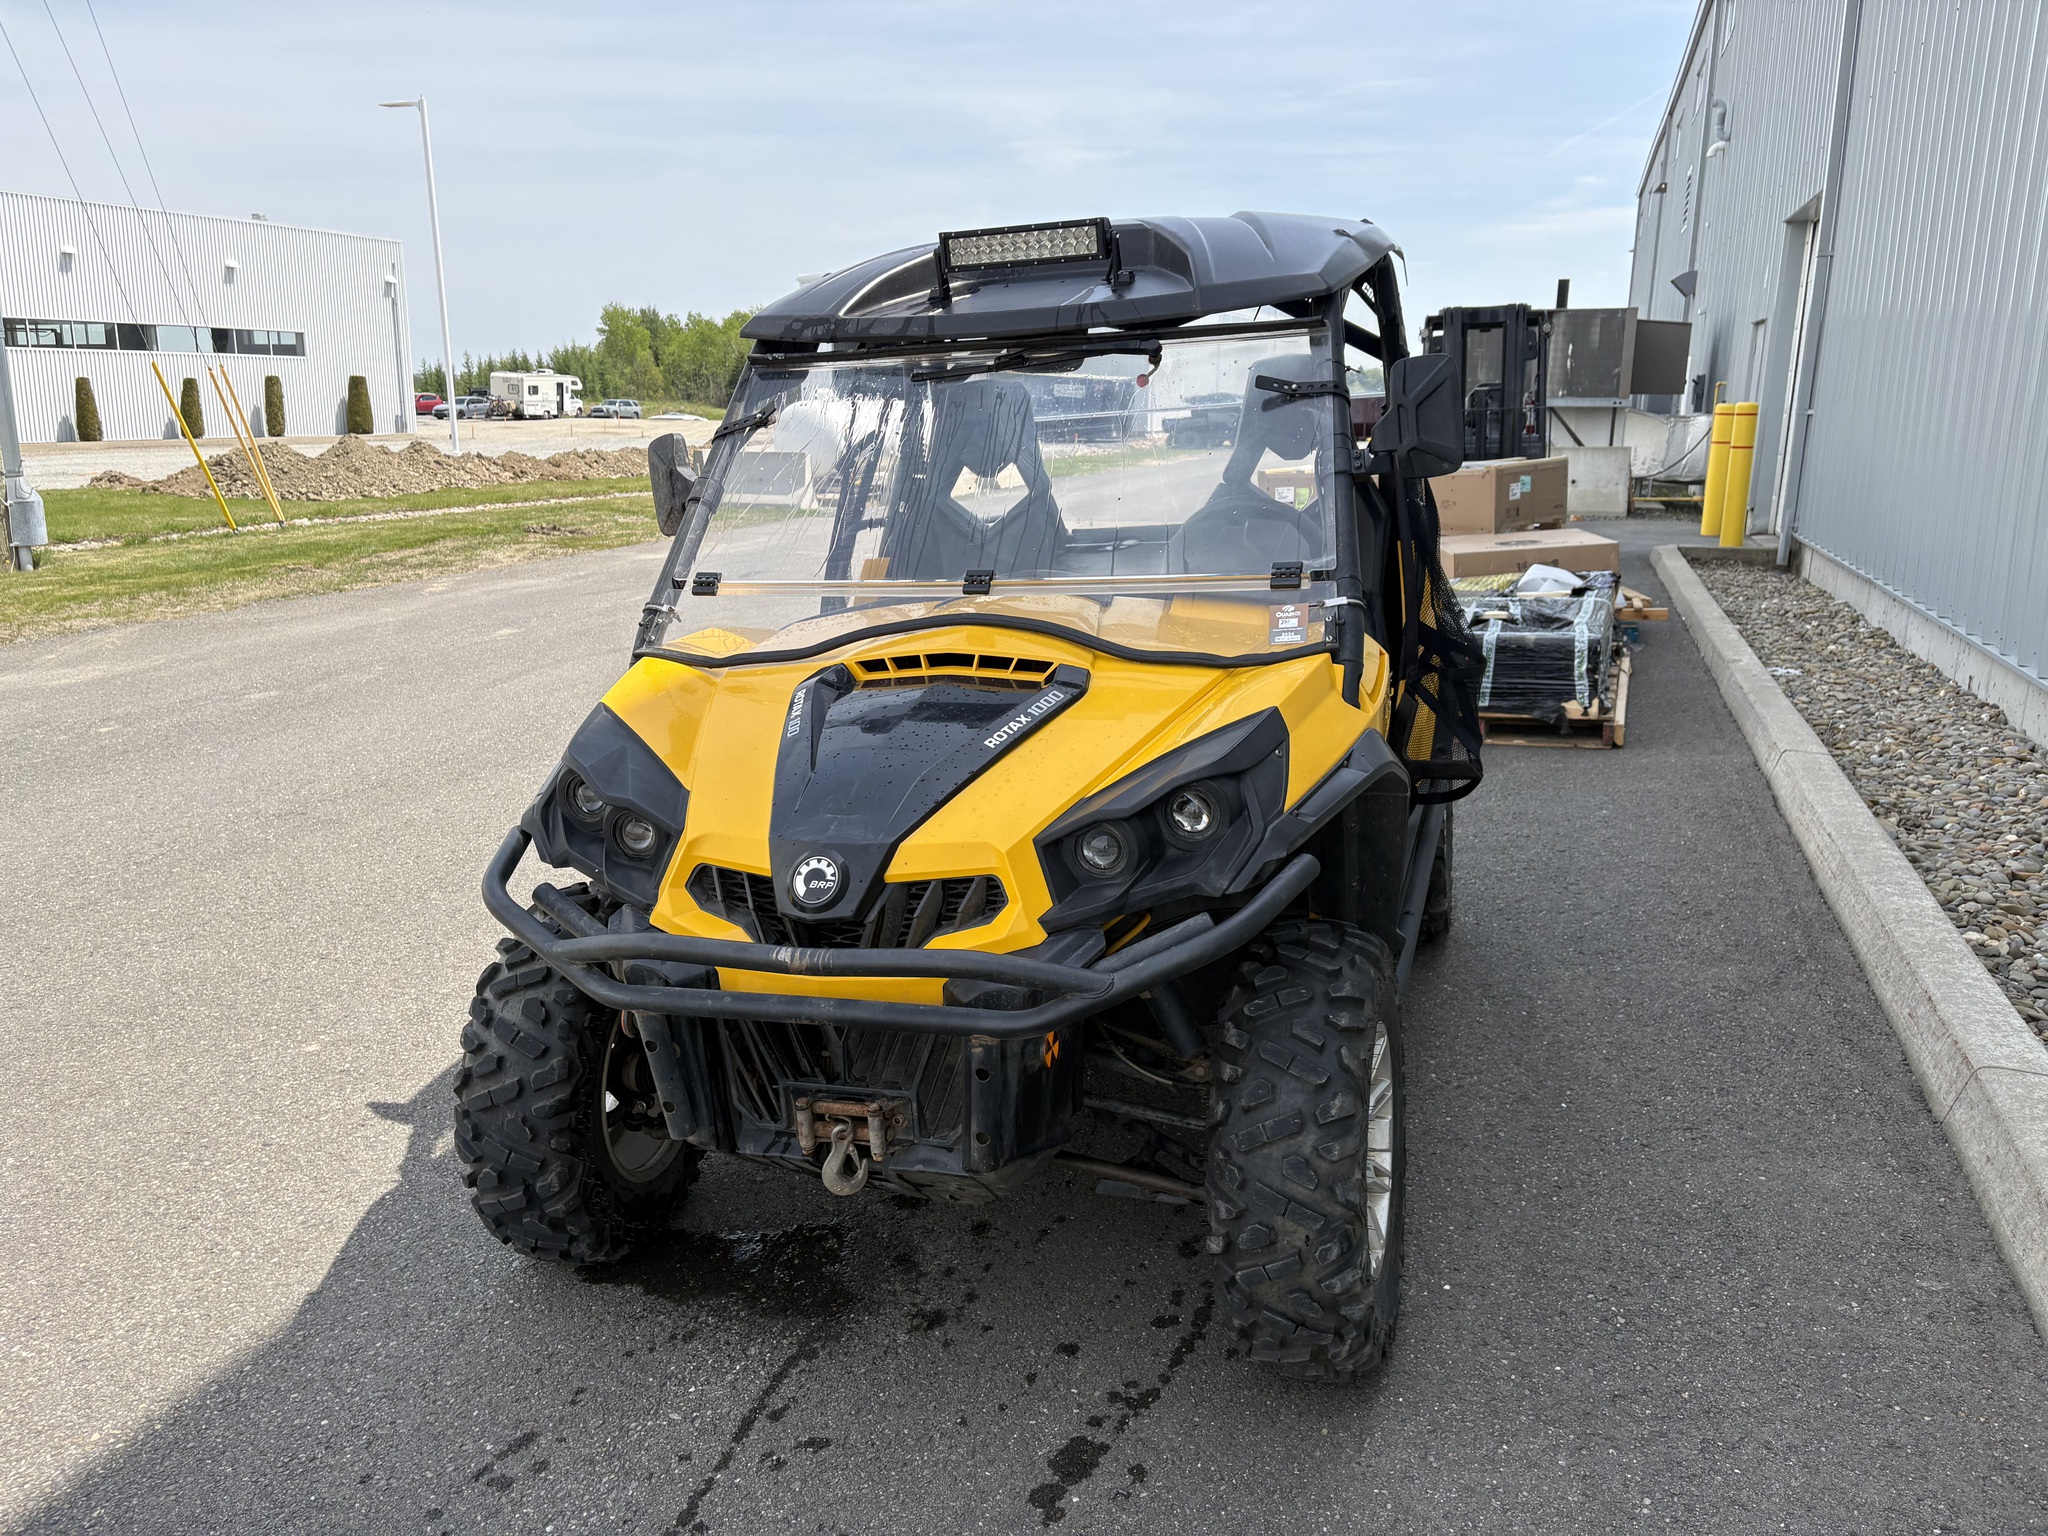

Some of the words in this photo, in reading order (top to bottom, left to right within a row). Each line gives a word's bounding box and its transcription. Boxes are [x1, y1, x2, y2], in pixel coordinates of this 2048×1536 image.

[790, 688, 806, 719] ROTAX
[983, 714, 1032, 749] ROTAX
[1027, 690, 1065, 717] 1000
[809, 880, 834, 890] BRP
